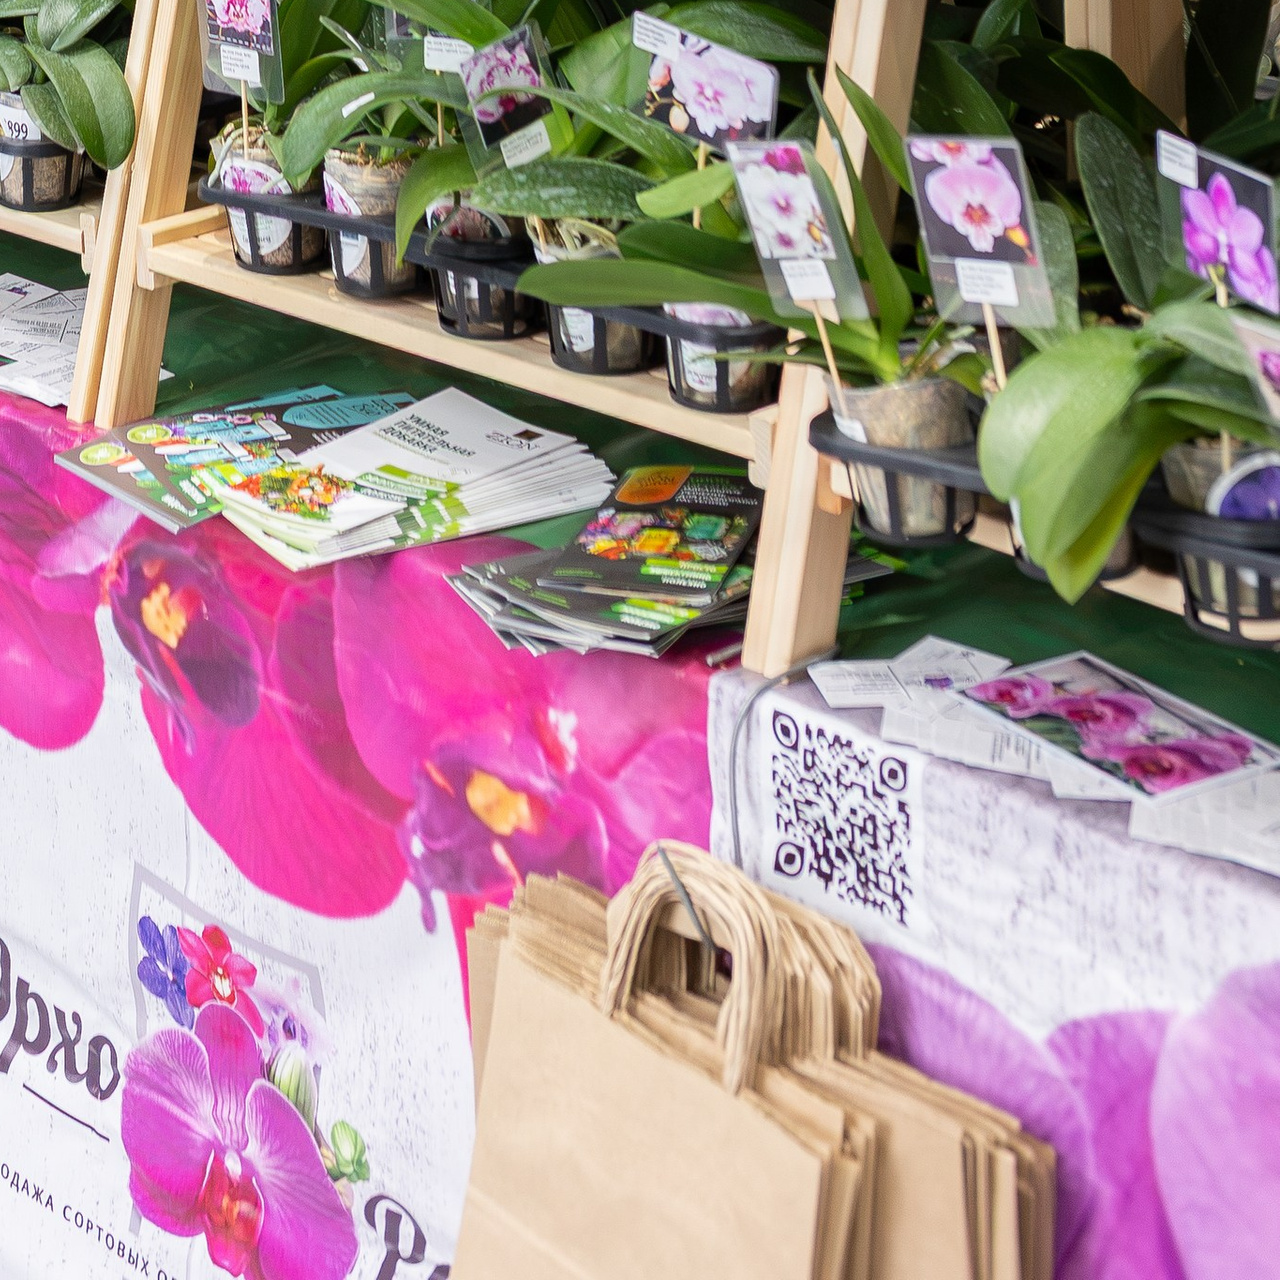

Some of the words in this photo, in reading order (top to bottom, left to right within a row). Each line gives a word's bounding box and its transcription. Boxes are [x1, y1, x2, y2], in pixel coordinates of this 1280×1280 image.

[4, 119, 29, 140] 899
[393, 420, 477, 459] ПИТАТЕЛЬНАЯ
[406, 413, 450, 437] УМНАЯ
[379, 427, 437, 456] ДОБАВКА
[62, 1204, 150, 1280] СОРТОВЫХ
